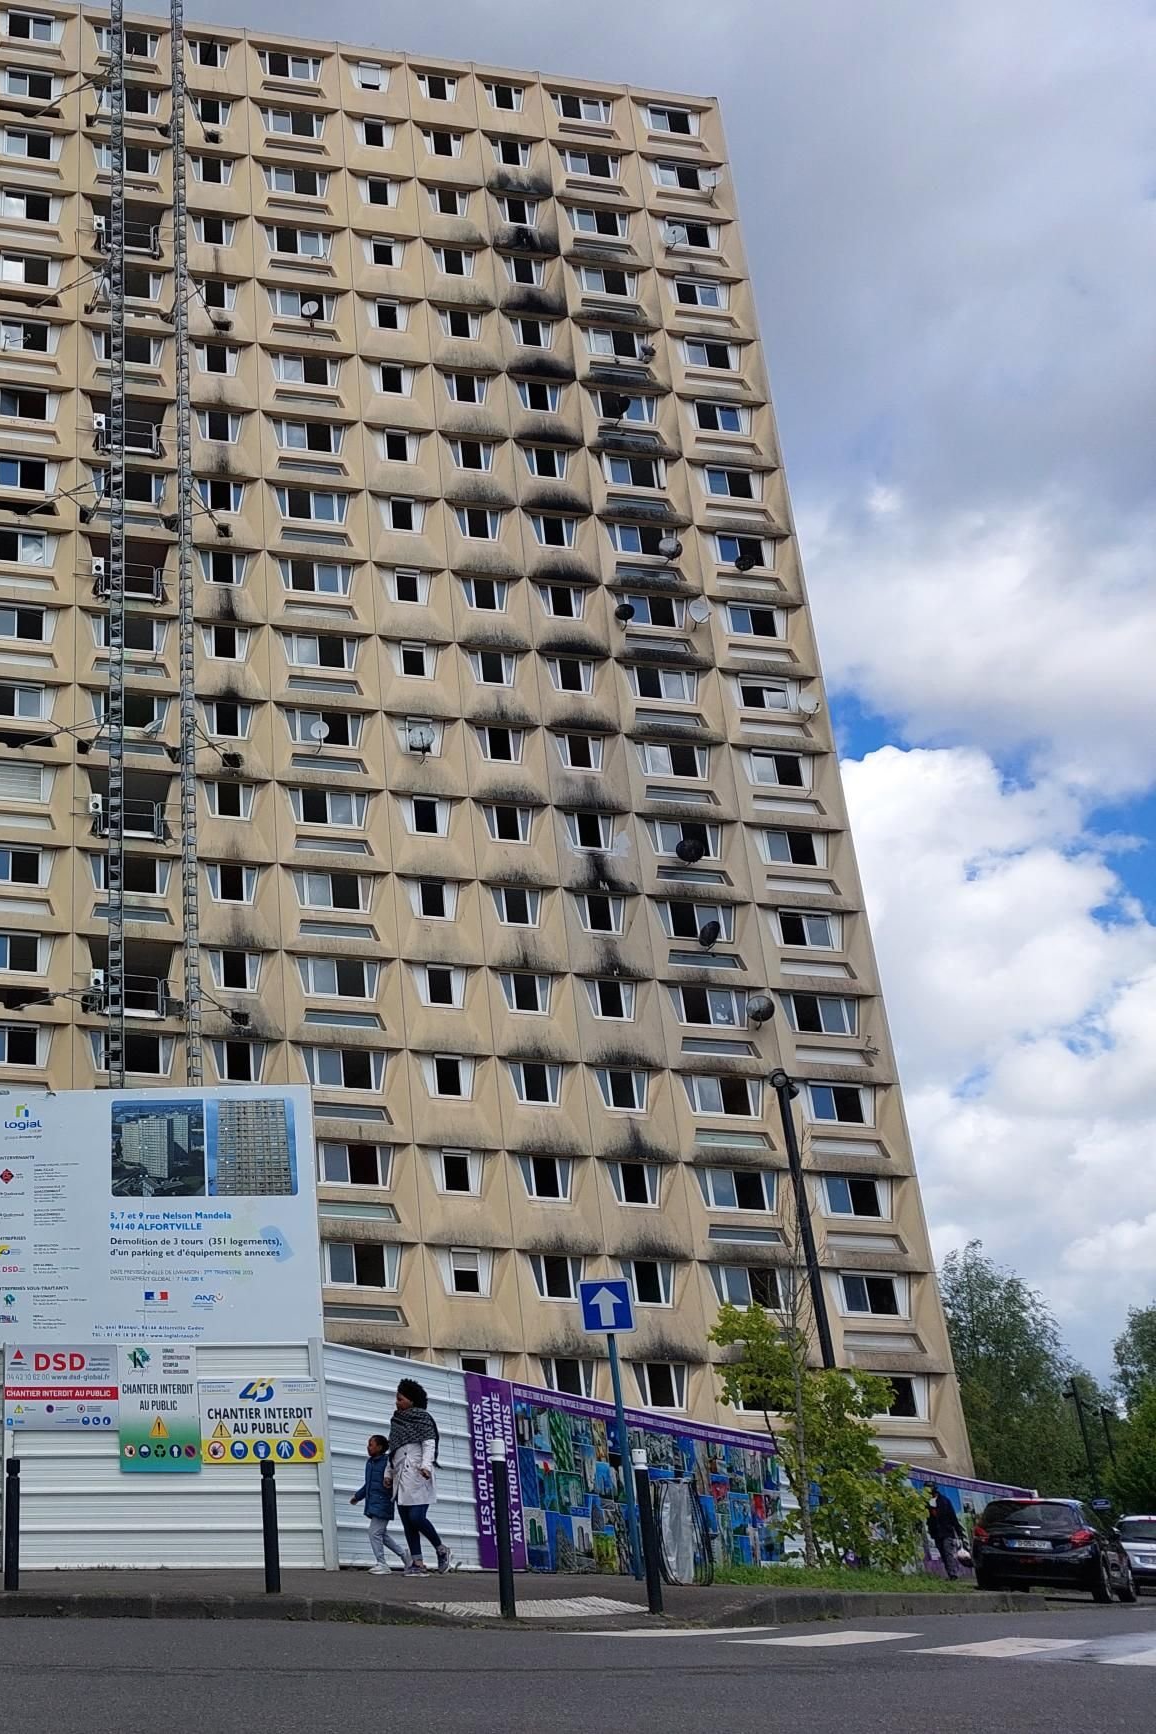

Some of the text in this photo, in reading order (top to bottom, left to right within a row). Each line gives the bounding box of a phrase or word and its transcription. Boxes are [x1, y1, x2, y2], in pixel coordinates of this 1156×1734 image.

[119, 1212, 125, 1220] 7
[138, 1212, 144, 1220] 9
[163, 1212, 193, 1220] Nelson
[195, 1212, 232, 1220] Mandela
[109, 1222, 202, 1231] 94140 ALFORTVILLE
[110, 1237, 158, 1246] Démolition
[208, 1238, 227, 1246] (351
[230, 1238, 283, 1248] logements),
[110, 1249, 129, 1257] d'un
[131, 1249, 164, 1258] parking
[177, 1249, 242, 1258] d'équipements
[34, 1353, 86, 1371] DSD
[51, 1373, 110, 1382] www.dsd-global.fr
[6, 1389, 111, 1397] CHANTIER INTERDIT AU PUBLIC
[122, 1383, 194, 1395] CHANTIER INTERDIT
[139, 1400, 178, 1411] AU PUBLIC
[207, 1407, 313, 1420] CHANTIER INTERDIT
[233, 1422, 290, 1435] AU PUBLIC
[501, 1404, 514, 1455] TOURS
[507, 1458, 520, 1505] TROIS
[481, 1505, 493, 1536] LES
[512, 1509, 523, 1543] AUX
